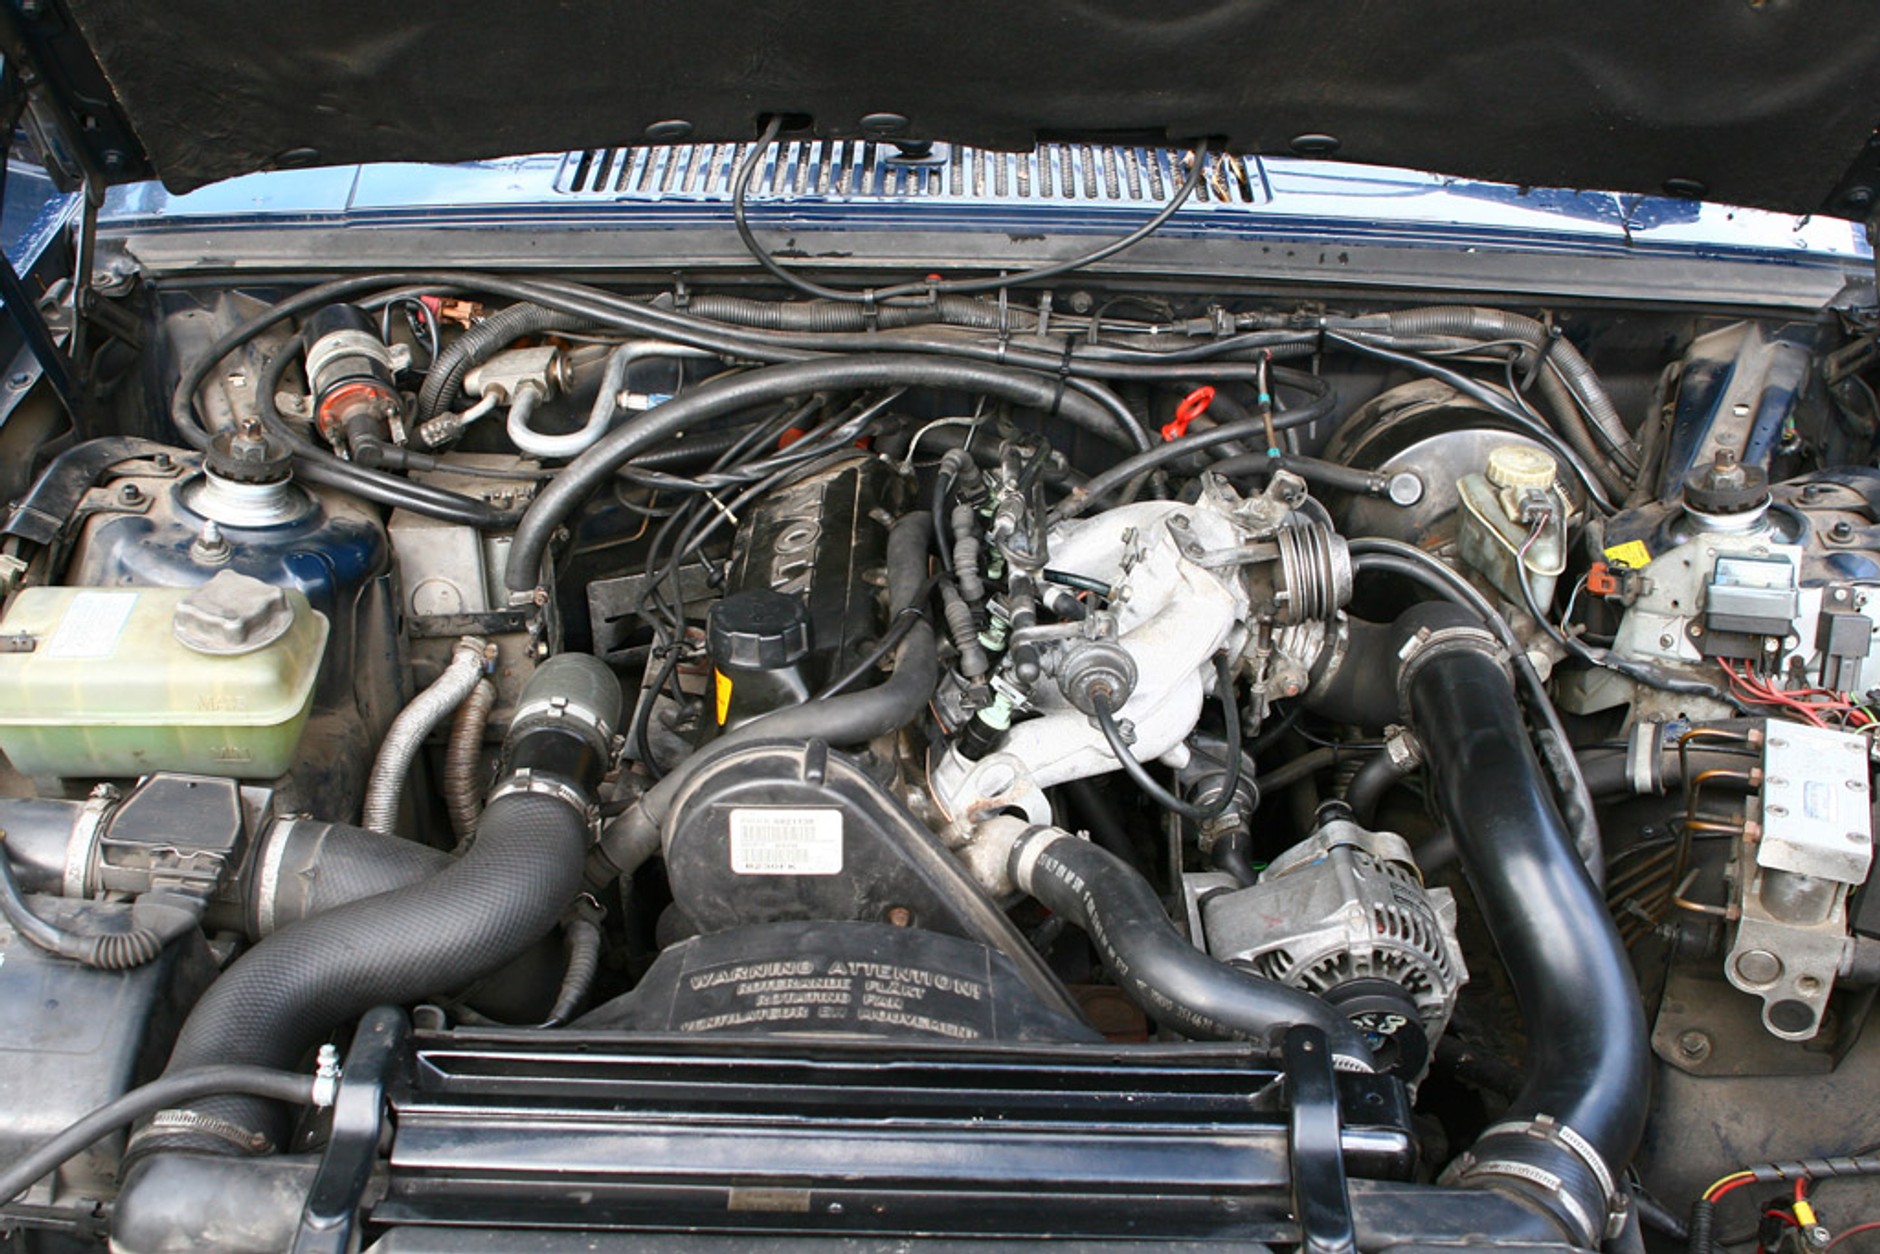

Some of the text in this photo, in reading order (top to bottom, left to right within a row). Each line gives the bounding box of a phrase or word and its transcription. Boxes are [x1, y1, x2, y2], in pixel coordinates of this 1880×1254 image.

[690, 961, 982, 1000] WARNING ATTENTION!
[863, 994, 904, 1009] FAN
[818, 1006, 847, 1018] EN
